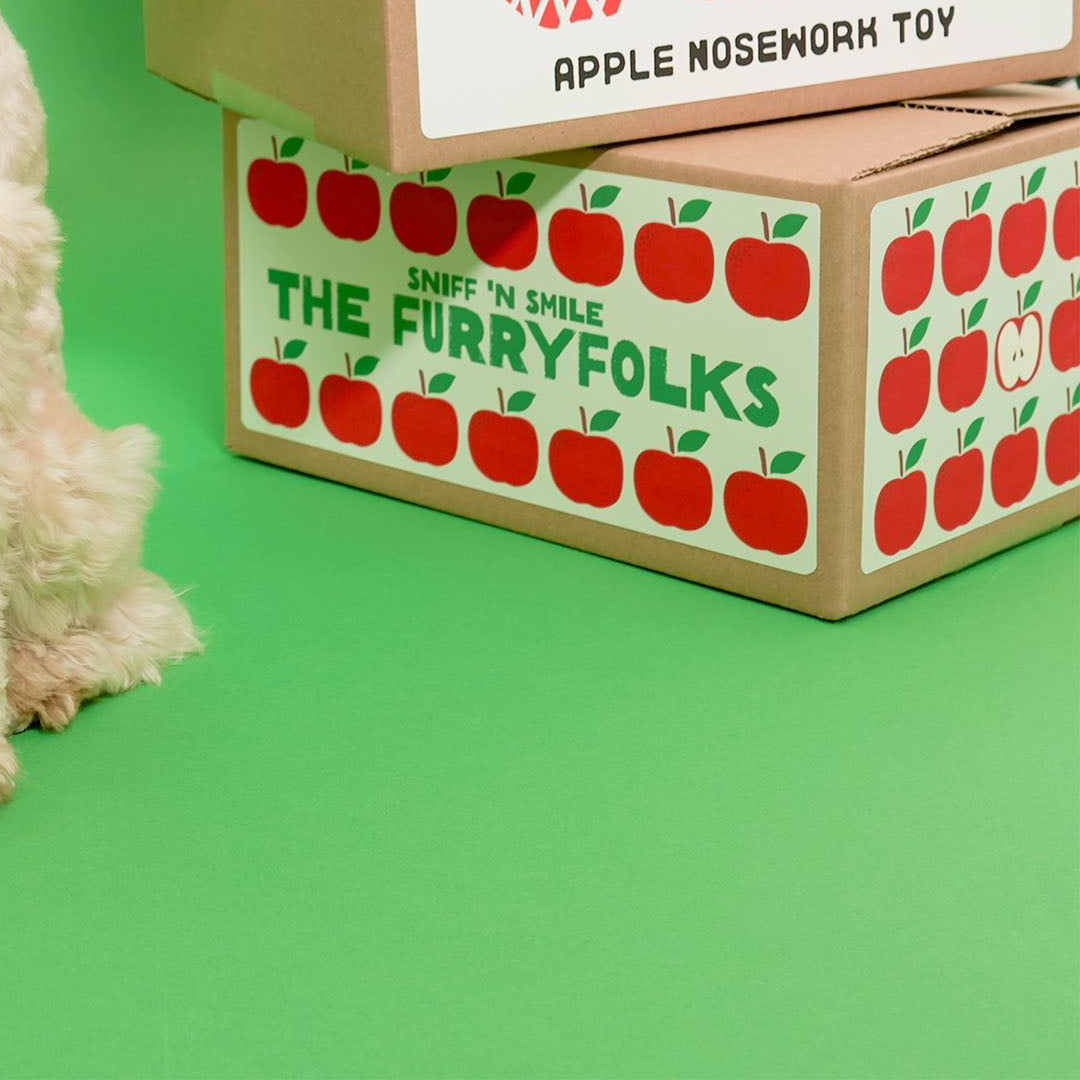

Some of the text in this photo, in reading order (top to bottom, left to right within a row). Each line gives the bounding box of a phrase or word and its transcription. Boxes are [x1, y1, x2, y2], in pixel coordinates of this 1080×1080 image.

[554, 5, 955, 92] APPLE NOSEWORK TOY
[406, 265, 604, 328] SNIFF 'N SMILE
[267, 267, 780, 428] THE FURRYFOLKS
